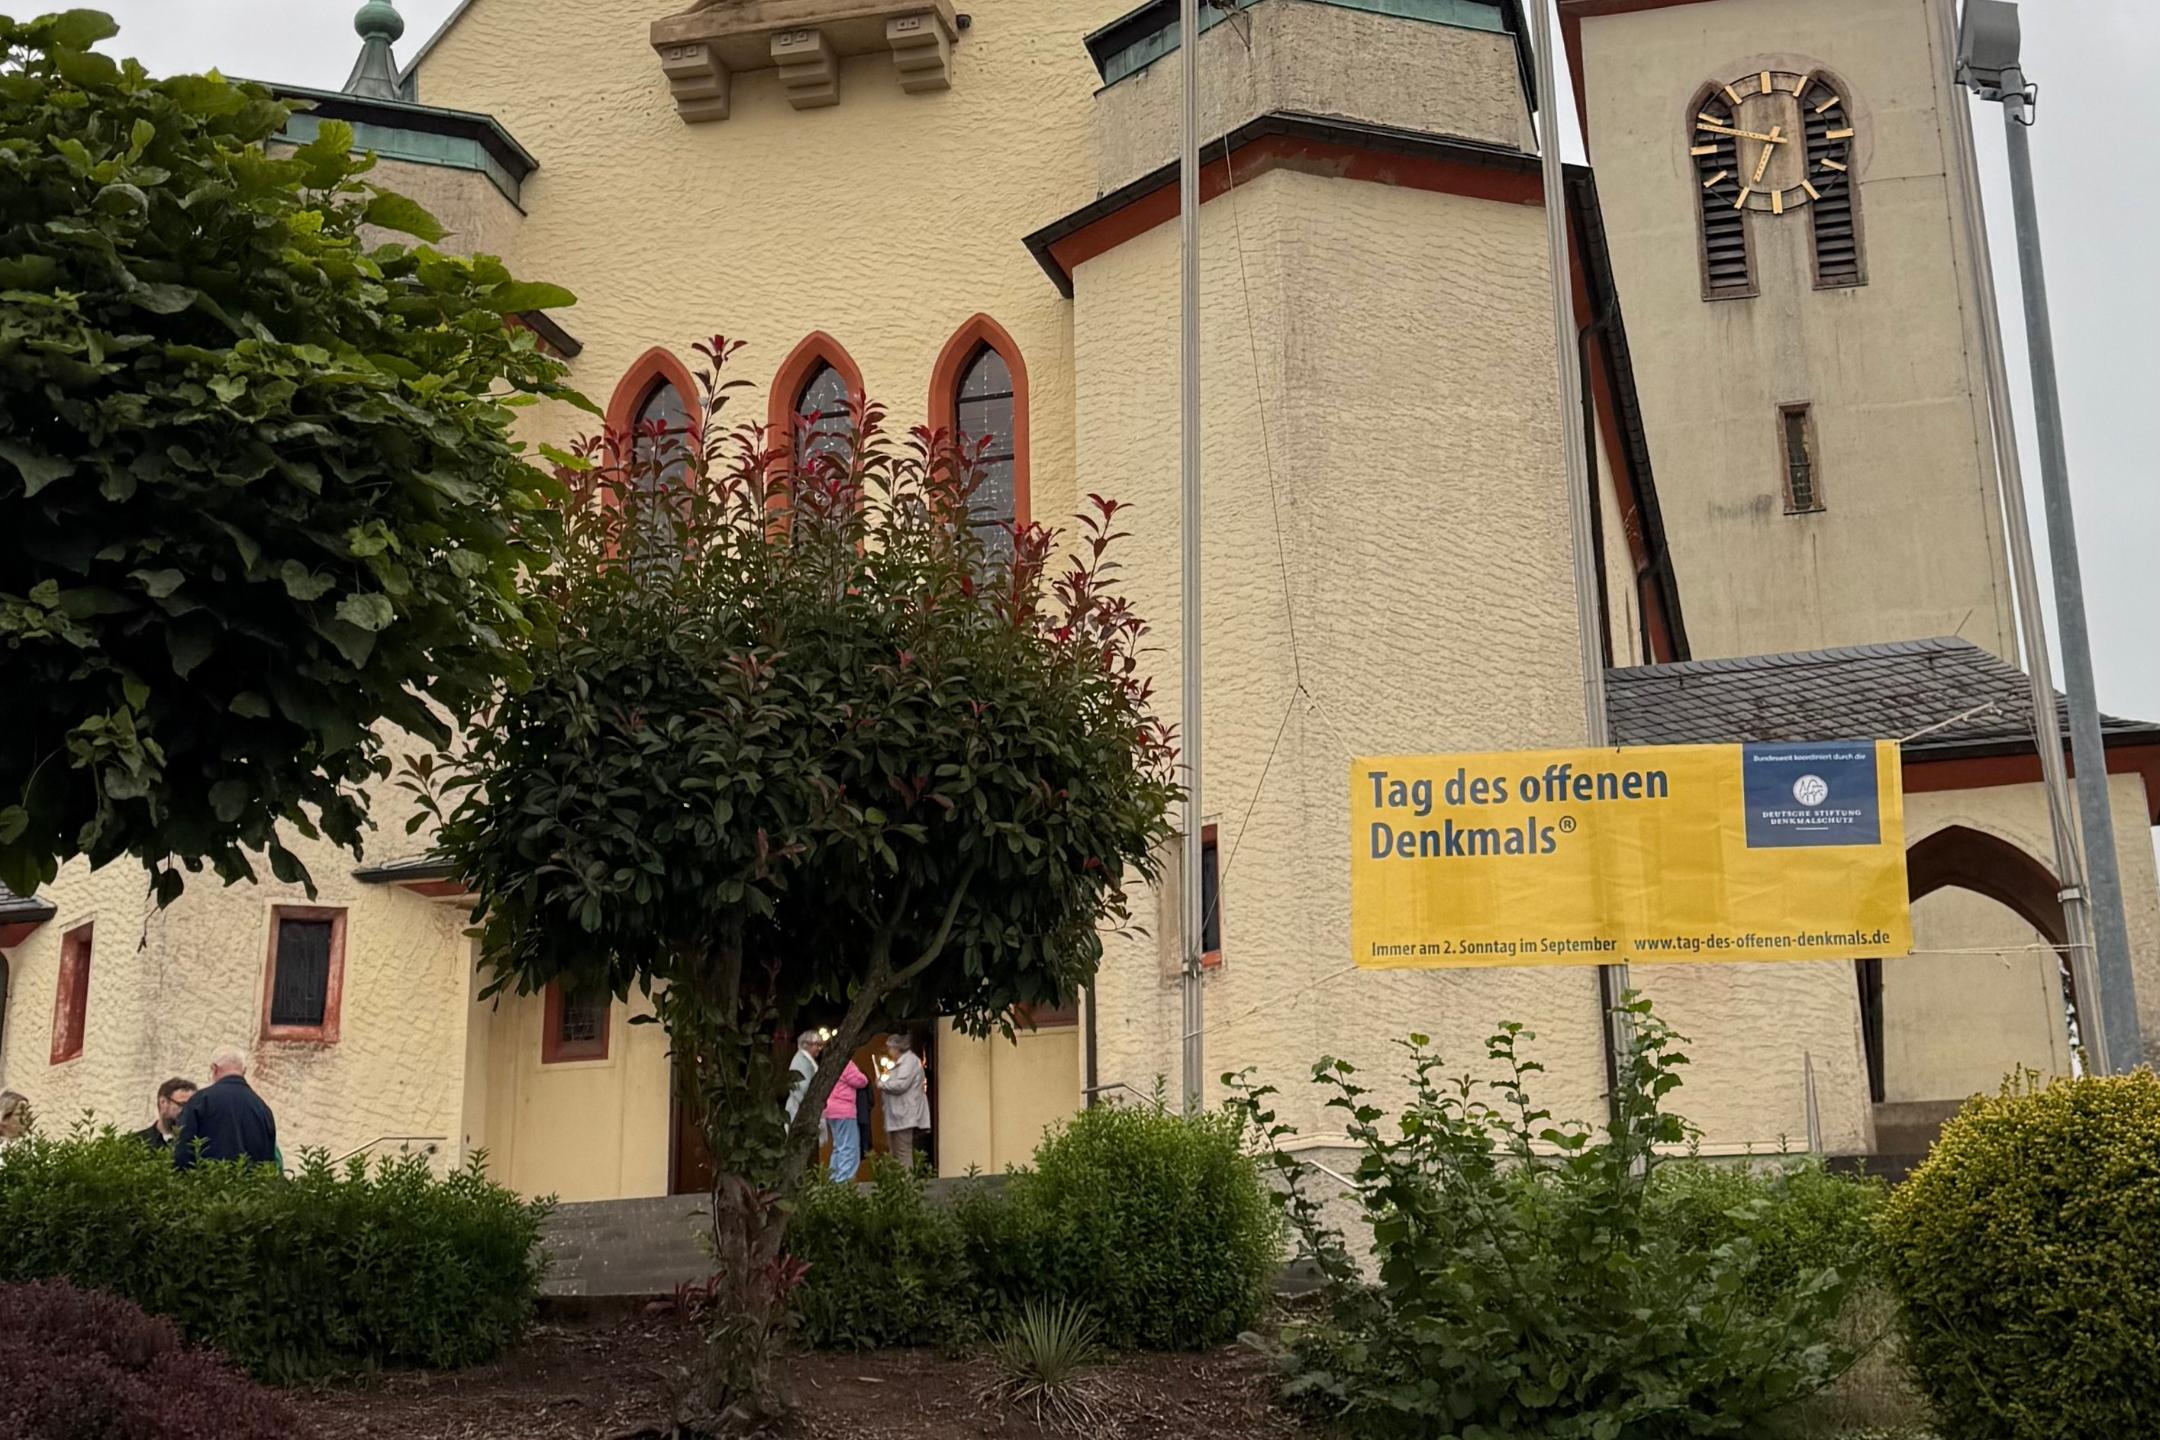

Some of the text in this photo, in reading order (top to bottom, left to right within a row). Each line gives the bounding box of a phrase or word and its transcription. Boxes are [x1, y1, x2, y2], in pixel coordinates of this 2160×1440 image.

[1834, 753, 1853, 761] durch
[1368, 762, 1668, 815] Tag des offenen
[1762, 809, 1862, 818] DEUTSCHE STIFTUNG
[1770, 817, 1854, 825] DENKMALSCHUTZ
[1372, 936, 1617, 957] Immer am 2. Sonntag im September
[1634, 930, 1890, 953] www.tag-des-offenen-denkmals.de
